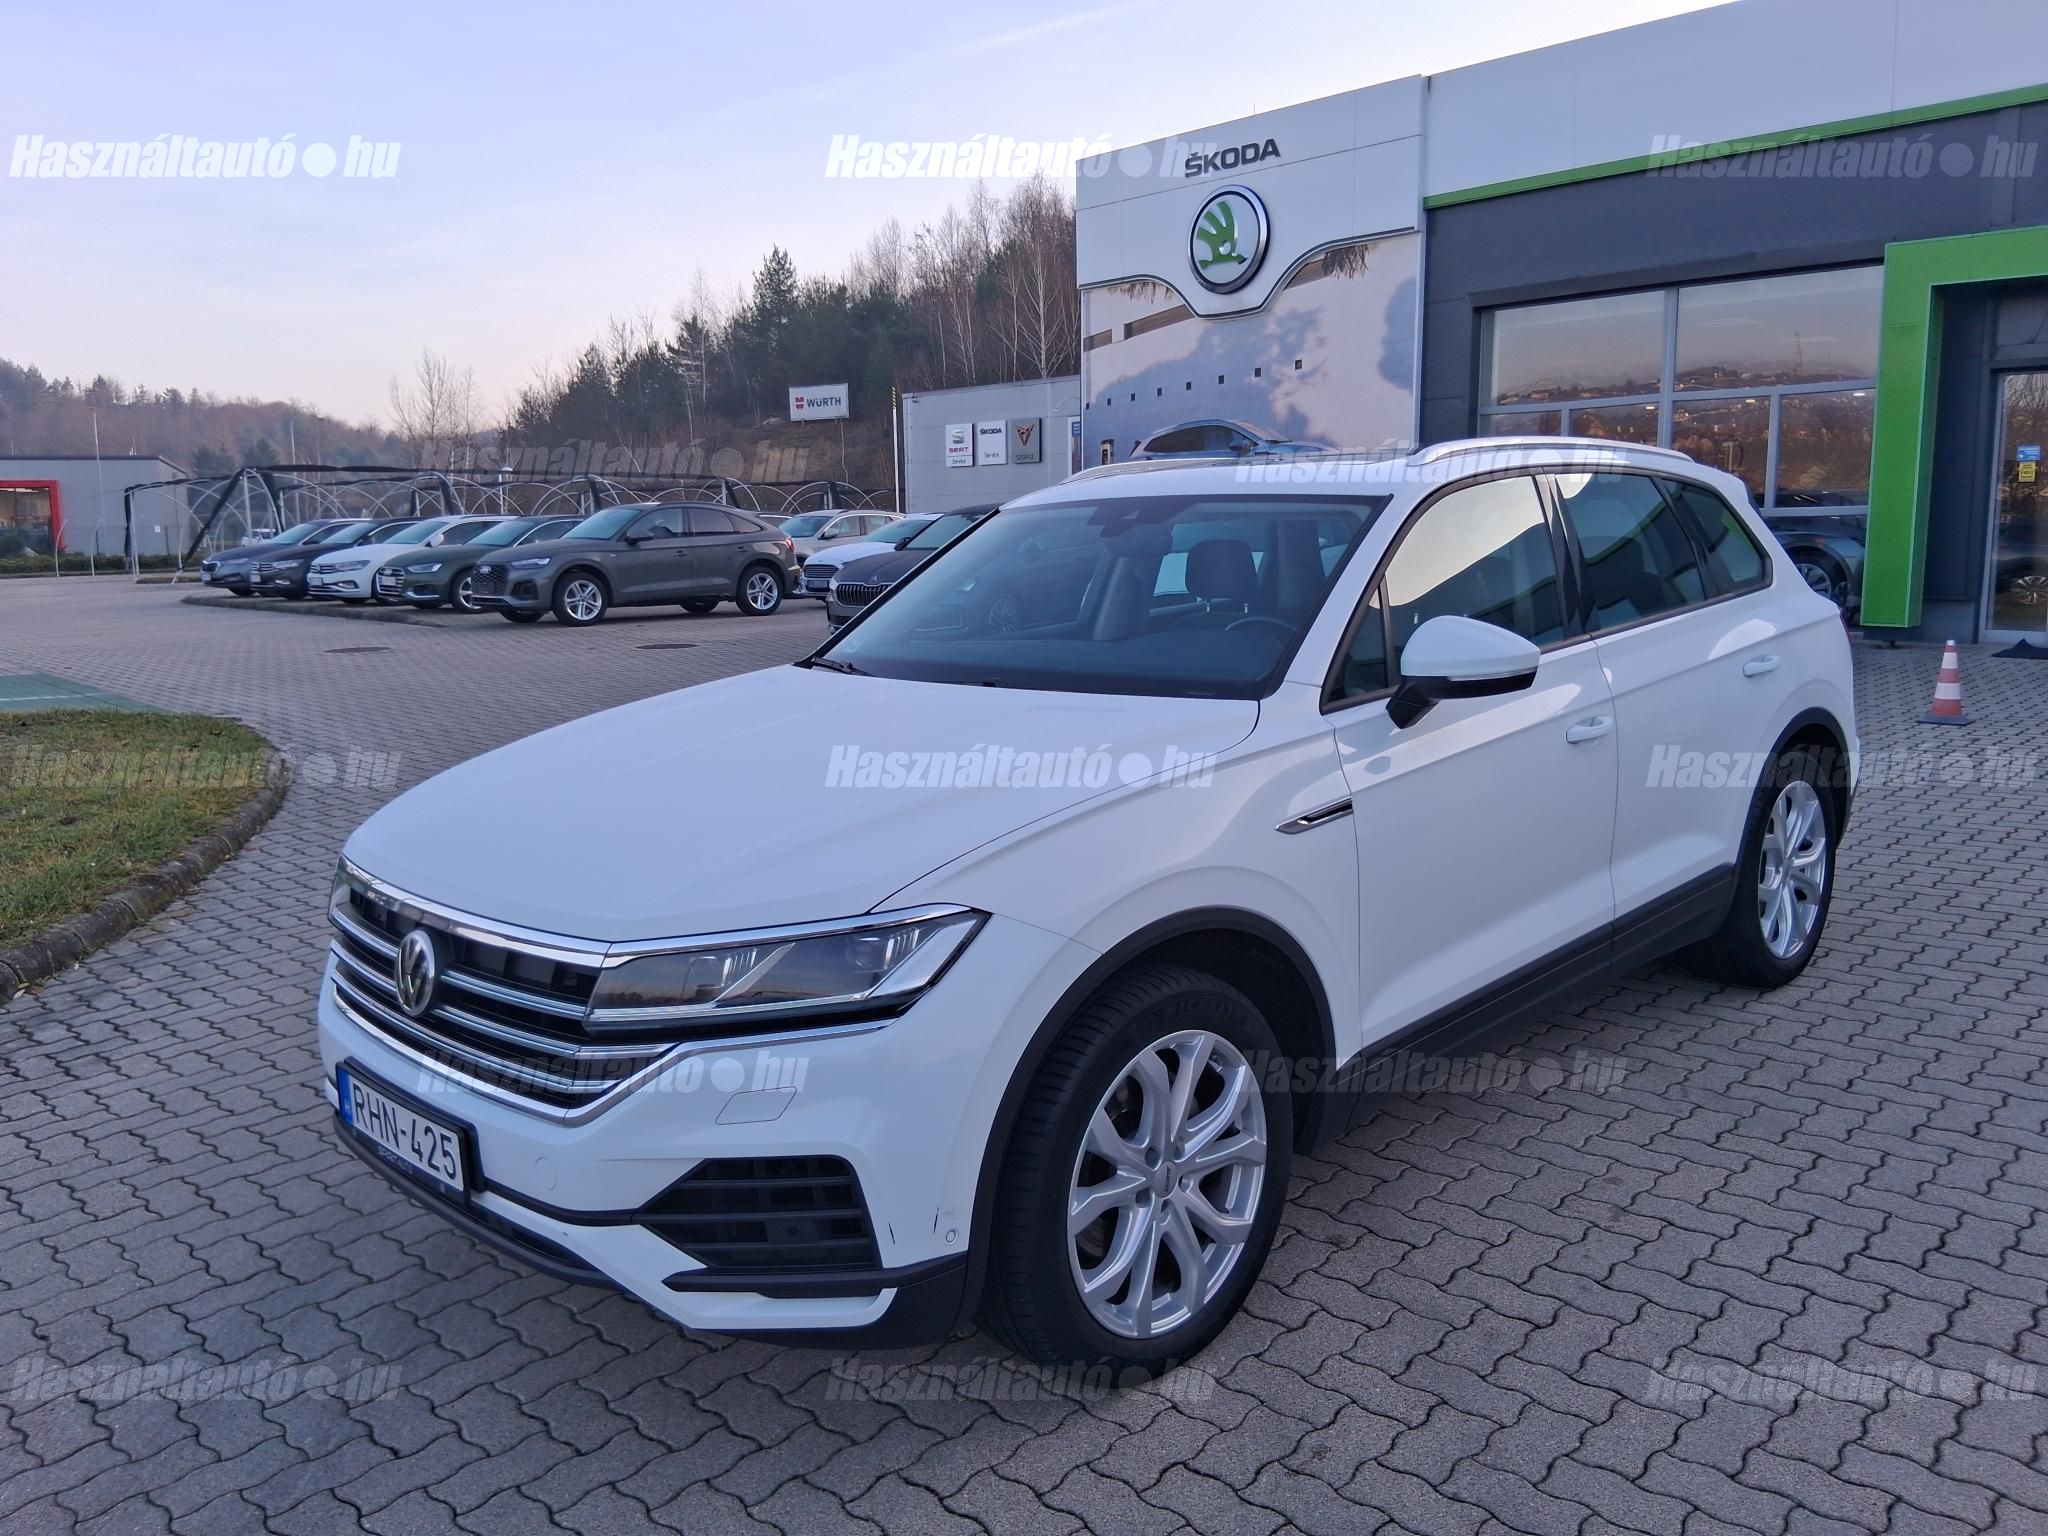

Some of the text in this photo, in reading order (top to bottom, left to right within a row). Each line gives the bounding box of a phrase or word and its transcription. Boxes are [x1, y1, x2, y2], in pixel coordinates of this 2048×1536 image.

[1184, 138, 1281, 178] ŠKODA
[806, 396, 841, 407] WÜRTH
[353, 1082, 456, 1180] RHN-425
